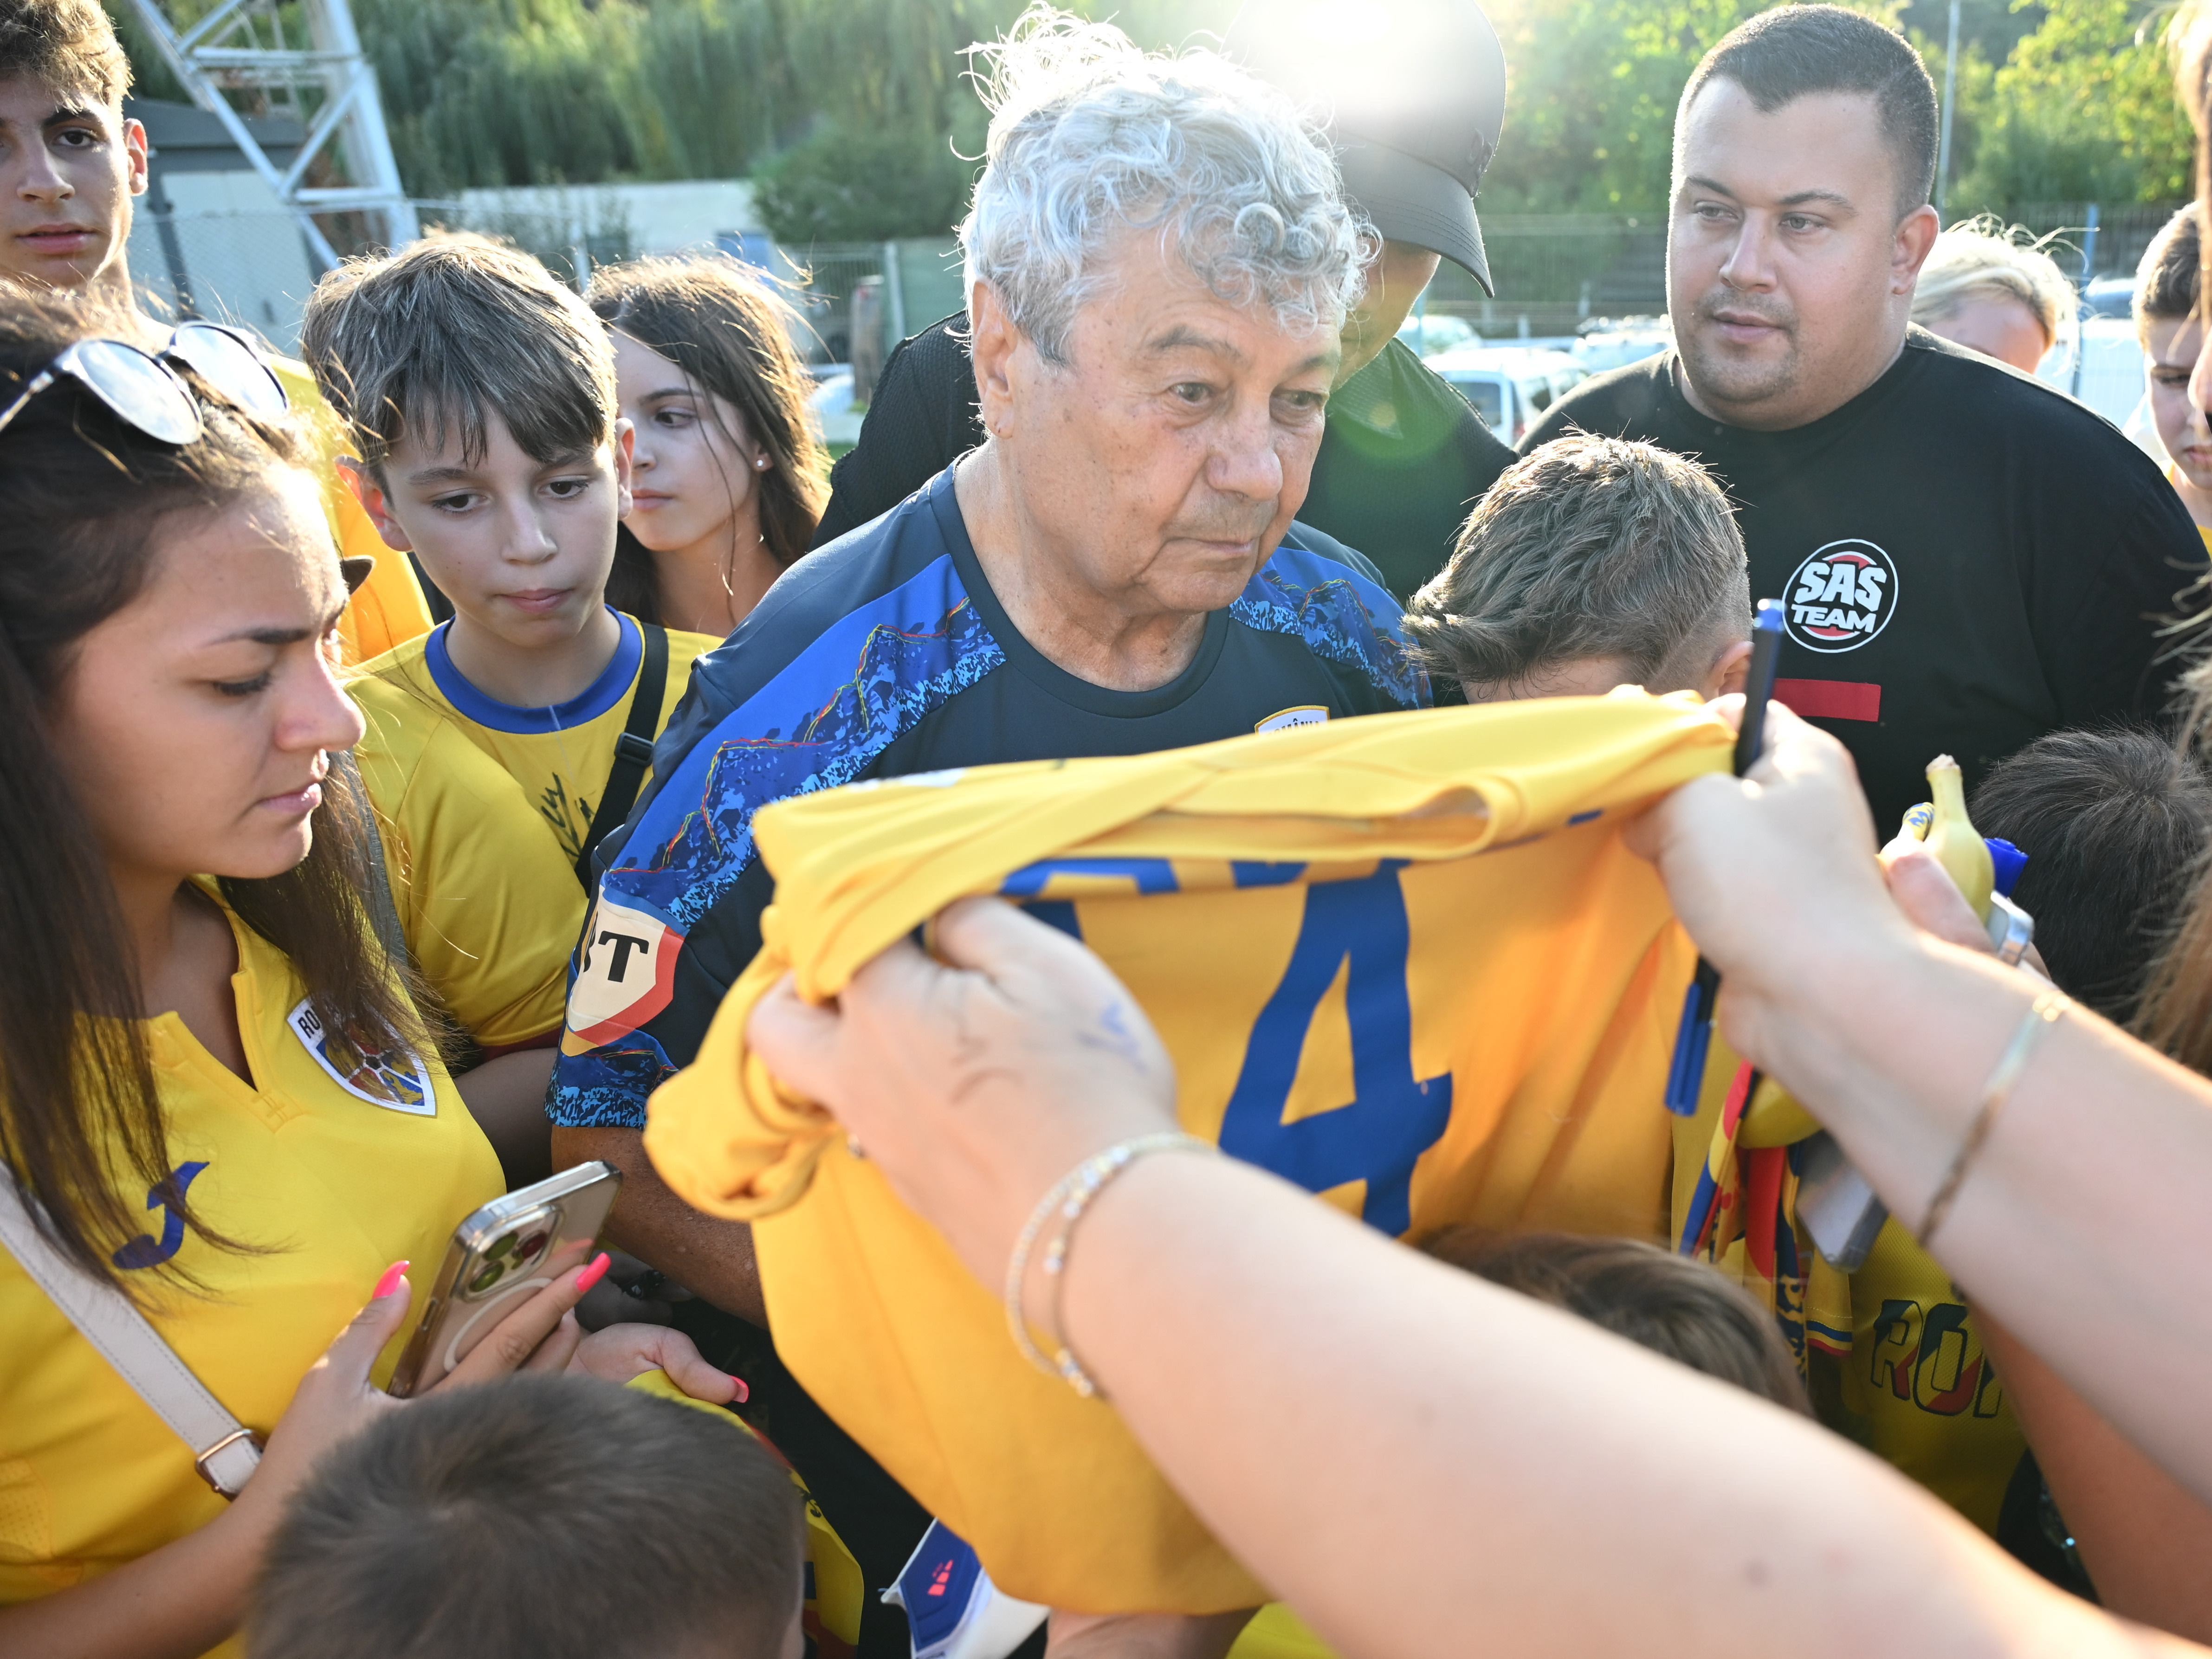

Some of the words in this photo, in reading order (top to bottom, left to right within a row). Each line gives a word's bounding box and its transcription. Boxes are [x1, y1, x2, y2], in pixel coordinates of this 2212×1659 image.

[1794, 562, 1887, 612] SAS
[1791, 604, 1877, 633] TEAM
[298, 1006, 323, 1039] RO
[1020, 859, 1453, 1239] 4
